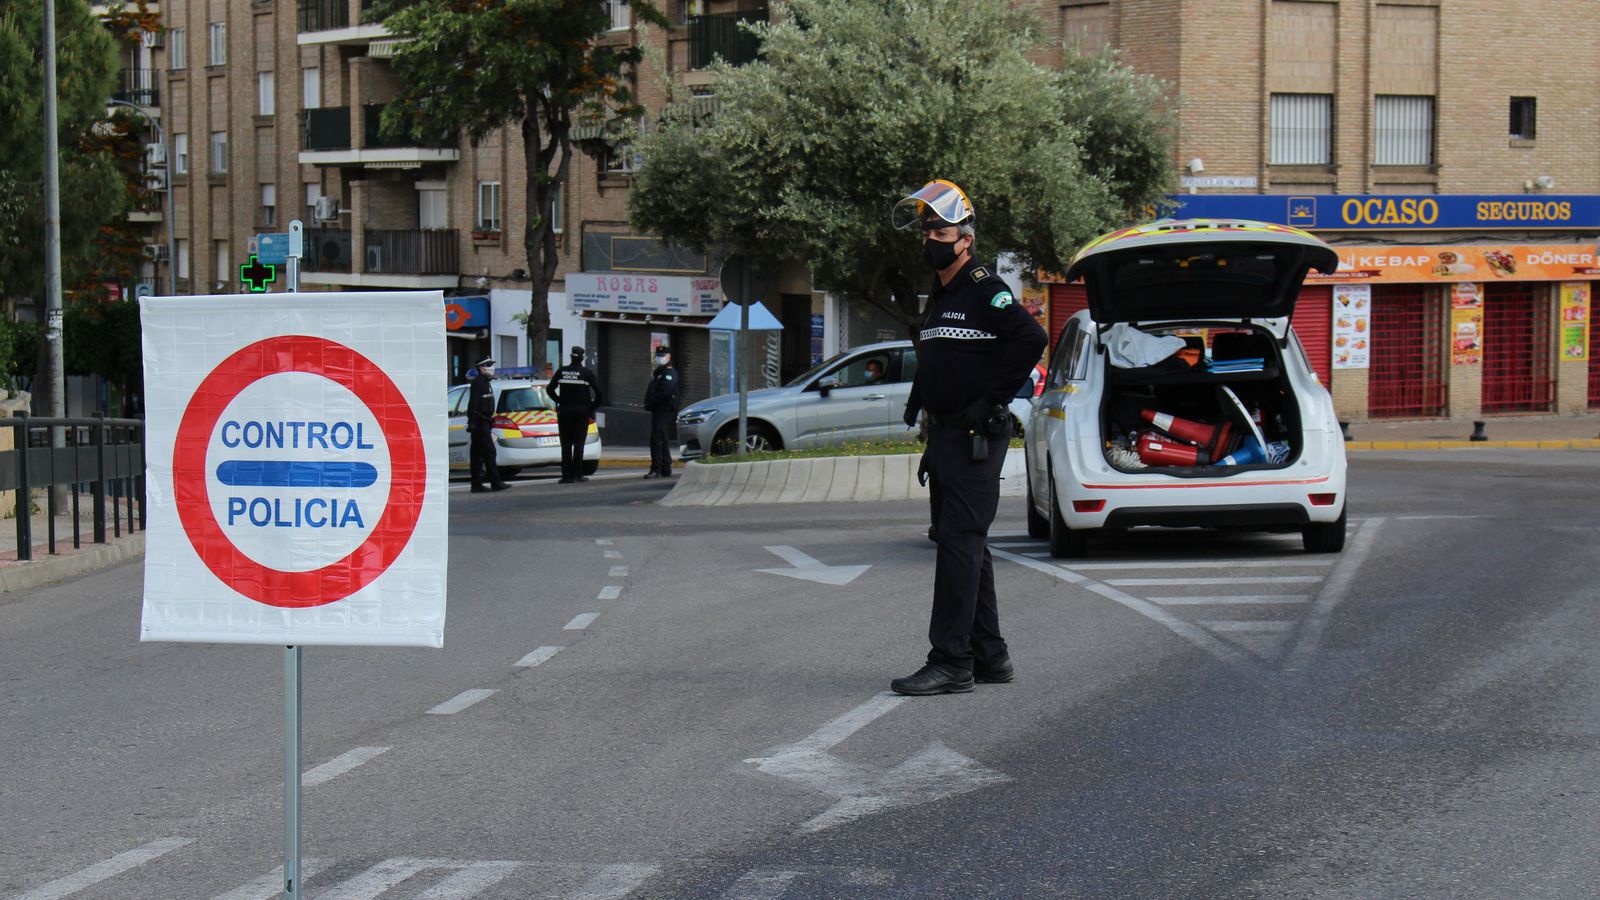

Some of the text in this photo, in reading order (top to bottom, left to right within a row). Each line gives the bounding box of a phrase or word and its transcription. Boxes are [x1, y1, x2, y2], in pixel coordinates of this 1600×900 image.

[1341, 199, 1571, 225] OCASO SEGUROS
[1359, 255, 1431, 267] KEBAP
[1526, 251, 1593, 265] DÖNER
[596, 277, 659, 293] ROSAS
[221, 420, 374, 450] CONTROL
[227, 496, 365, 529] POLICIA
